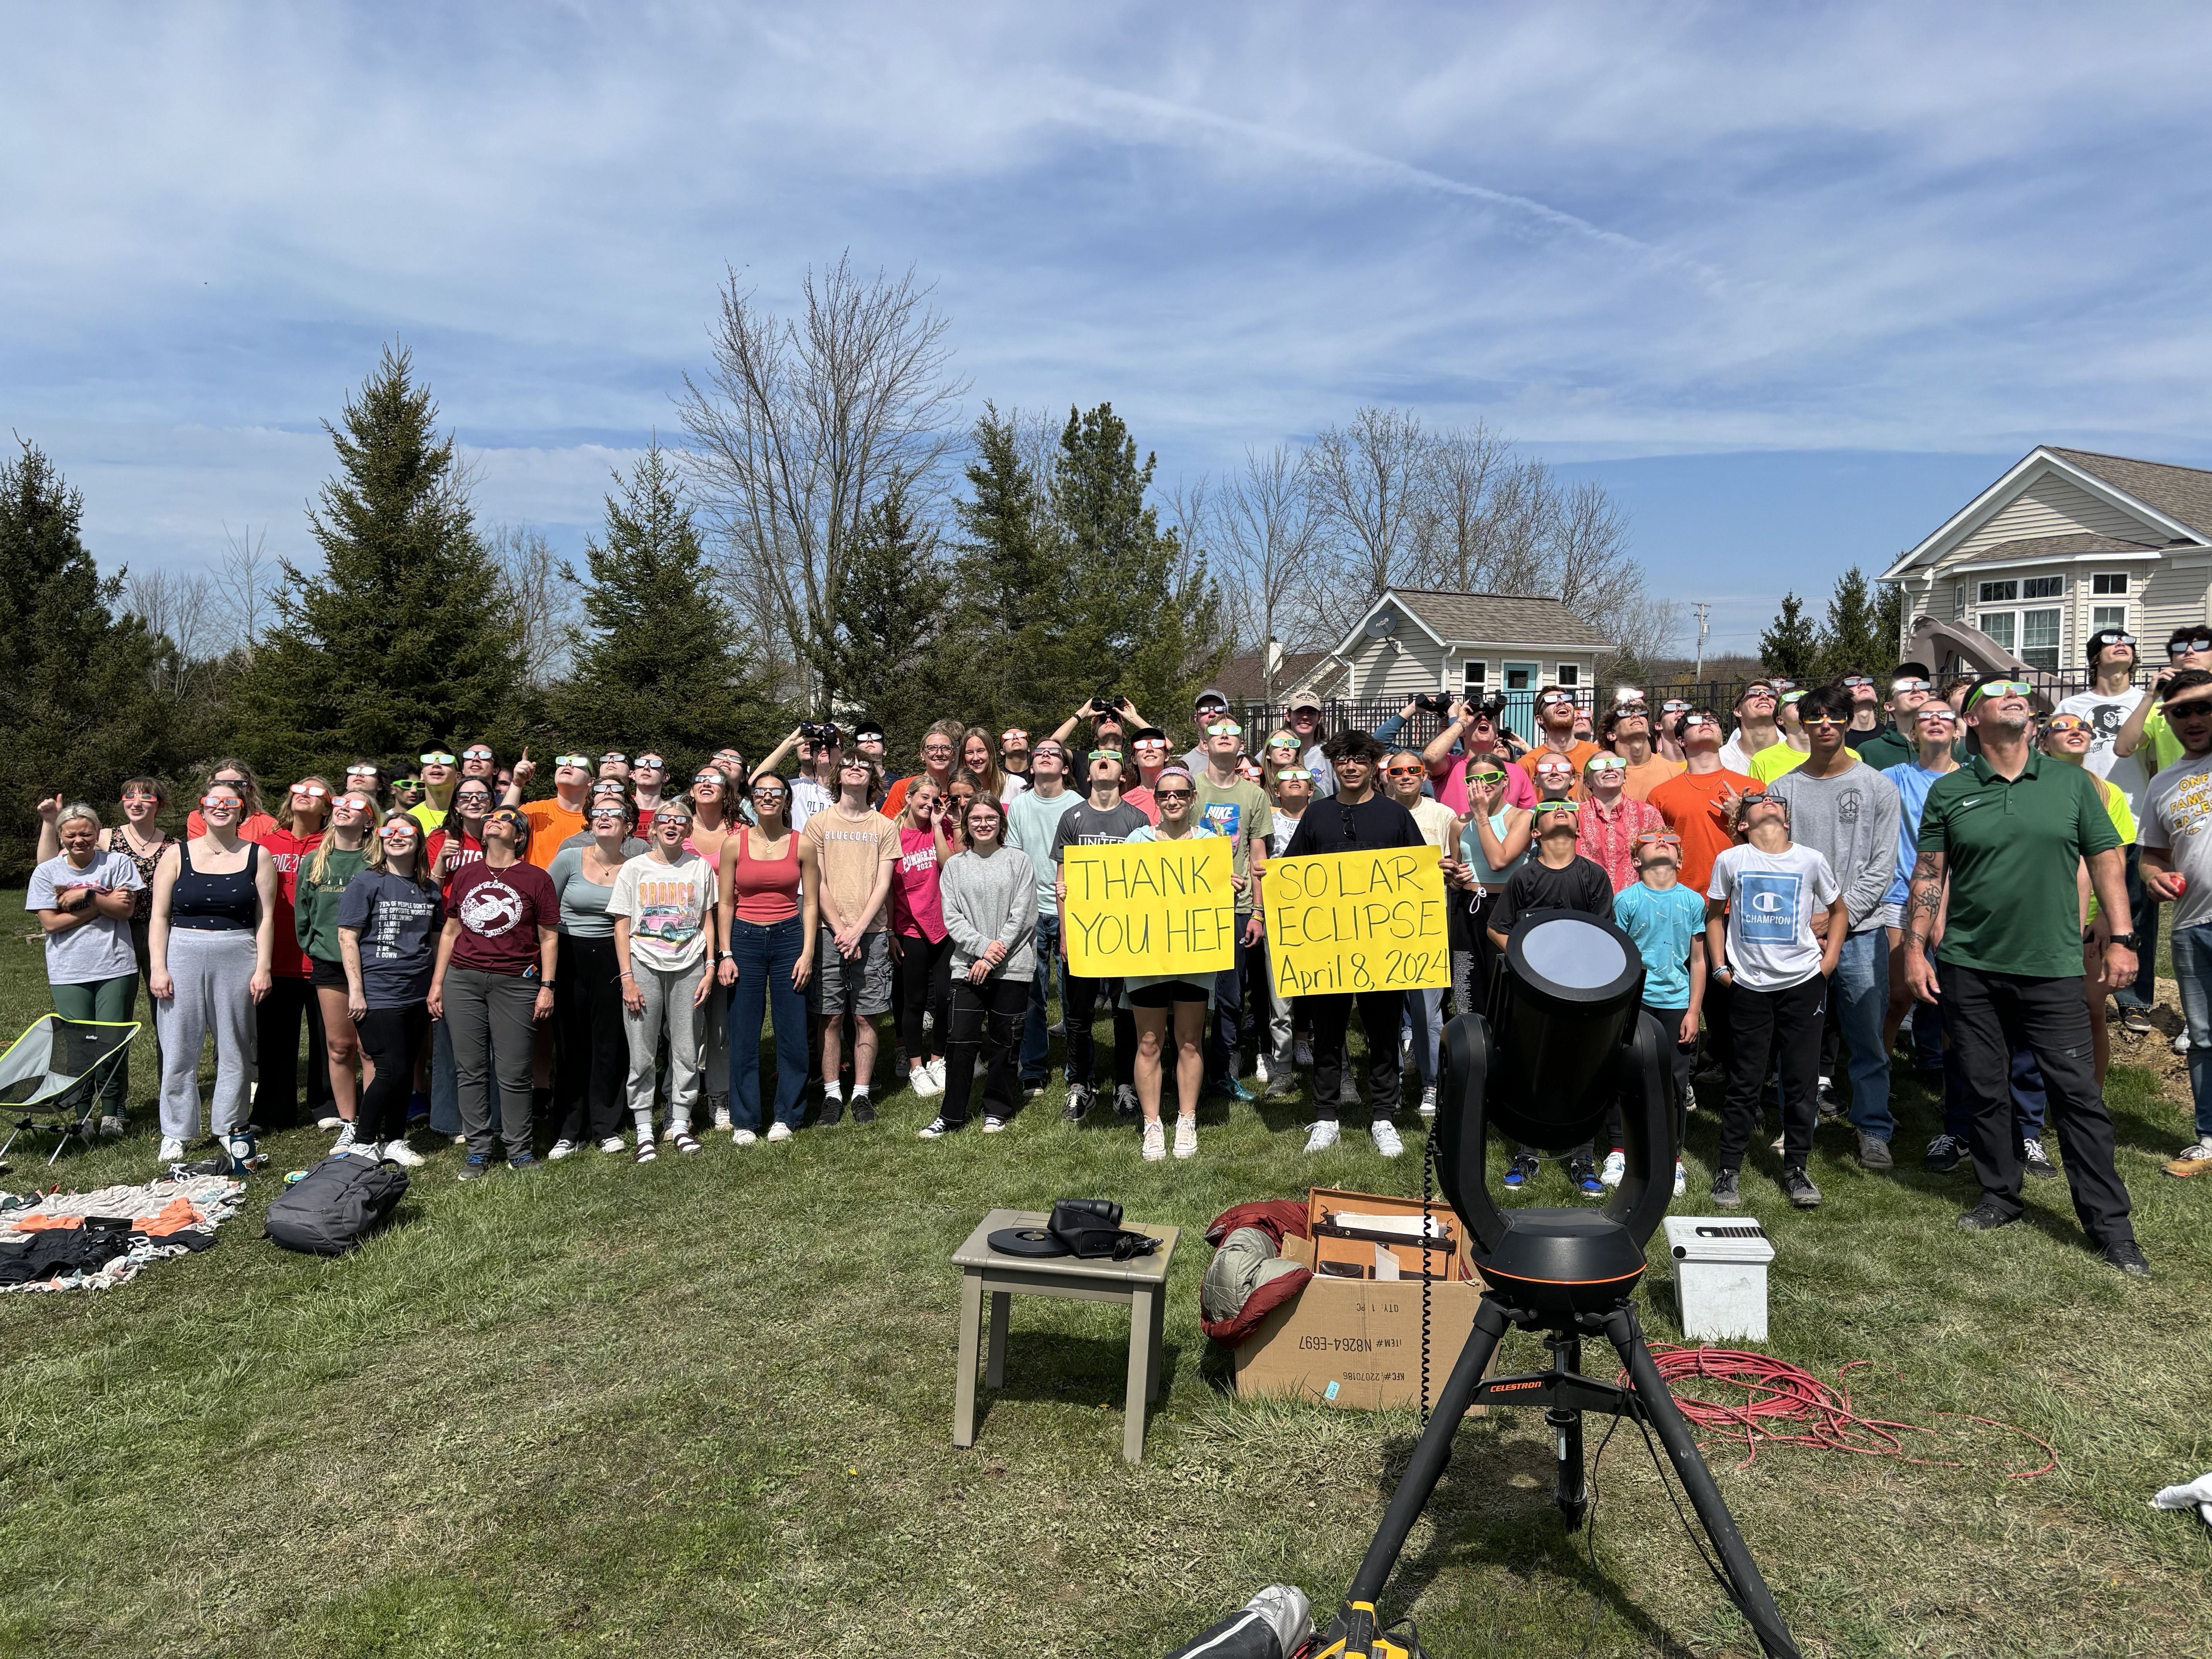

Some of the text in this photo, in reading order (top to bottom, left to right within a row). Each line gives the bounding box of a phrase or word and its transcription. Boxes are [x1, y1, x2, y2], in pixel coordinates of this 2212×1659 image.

[1205, 806, 1234, 819] NIKE
[825, 831, 878, 843] BLUECOATS
[917, 861, 933, 871] 2022
[1070, 855, 1211, 900] THANK
[1279, 855, 1424, 900] SOLAR
[1278, 901, 1442, 946] ECLIPSE
[1746, 914, 1790, 925] CHAMPION
[1071, 907, 1235, 957] YOU HEF
[1280, 955, 1342, 995] April
[1351, 953, 1375, 990] 8,
[1386, 948, 1448, 984] 2024
[1357, 1303, 1399, 1312] QTY: 1 PC
[1299, 1336, 1372, 1352] N8264-E697
[1343, 1372, 1380, 1381] 22070186
[1490, 1381, 1542, 1393] CELESTRON
